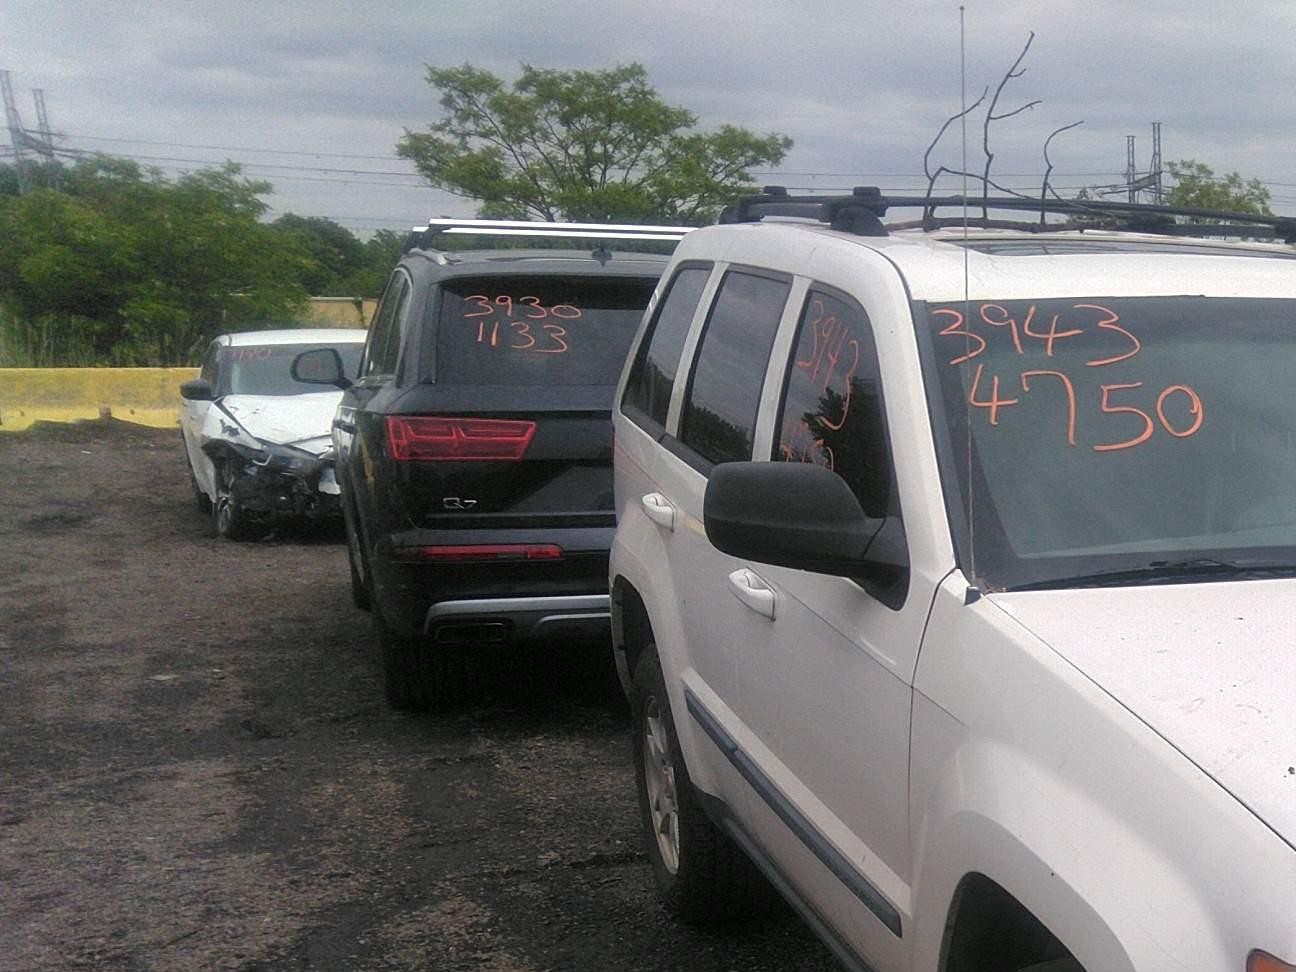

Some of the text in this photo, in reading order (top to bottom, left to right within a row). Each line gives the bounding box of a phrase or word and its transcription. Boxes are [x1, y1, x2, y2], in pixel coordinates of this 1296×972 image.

[464, 295, 582, 319] 3930
[476, 321, 568, 353] 1133
[932, 303, 1141, 366] 3943
[968, 363, 1205, 452] 4750
